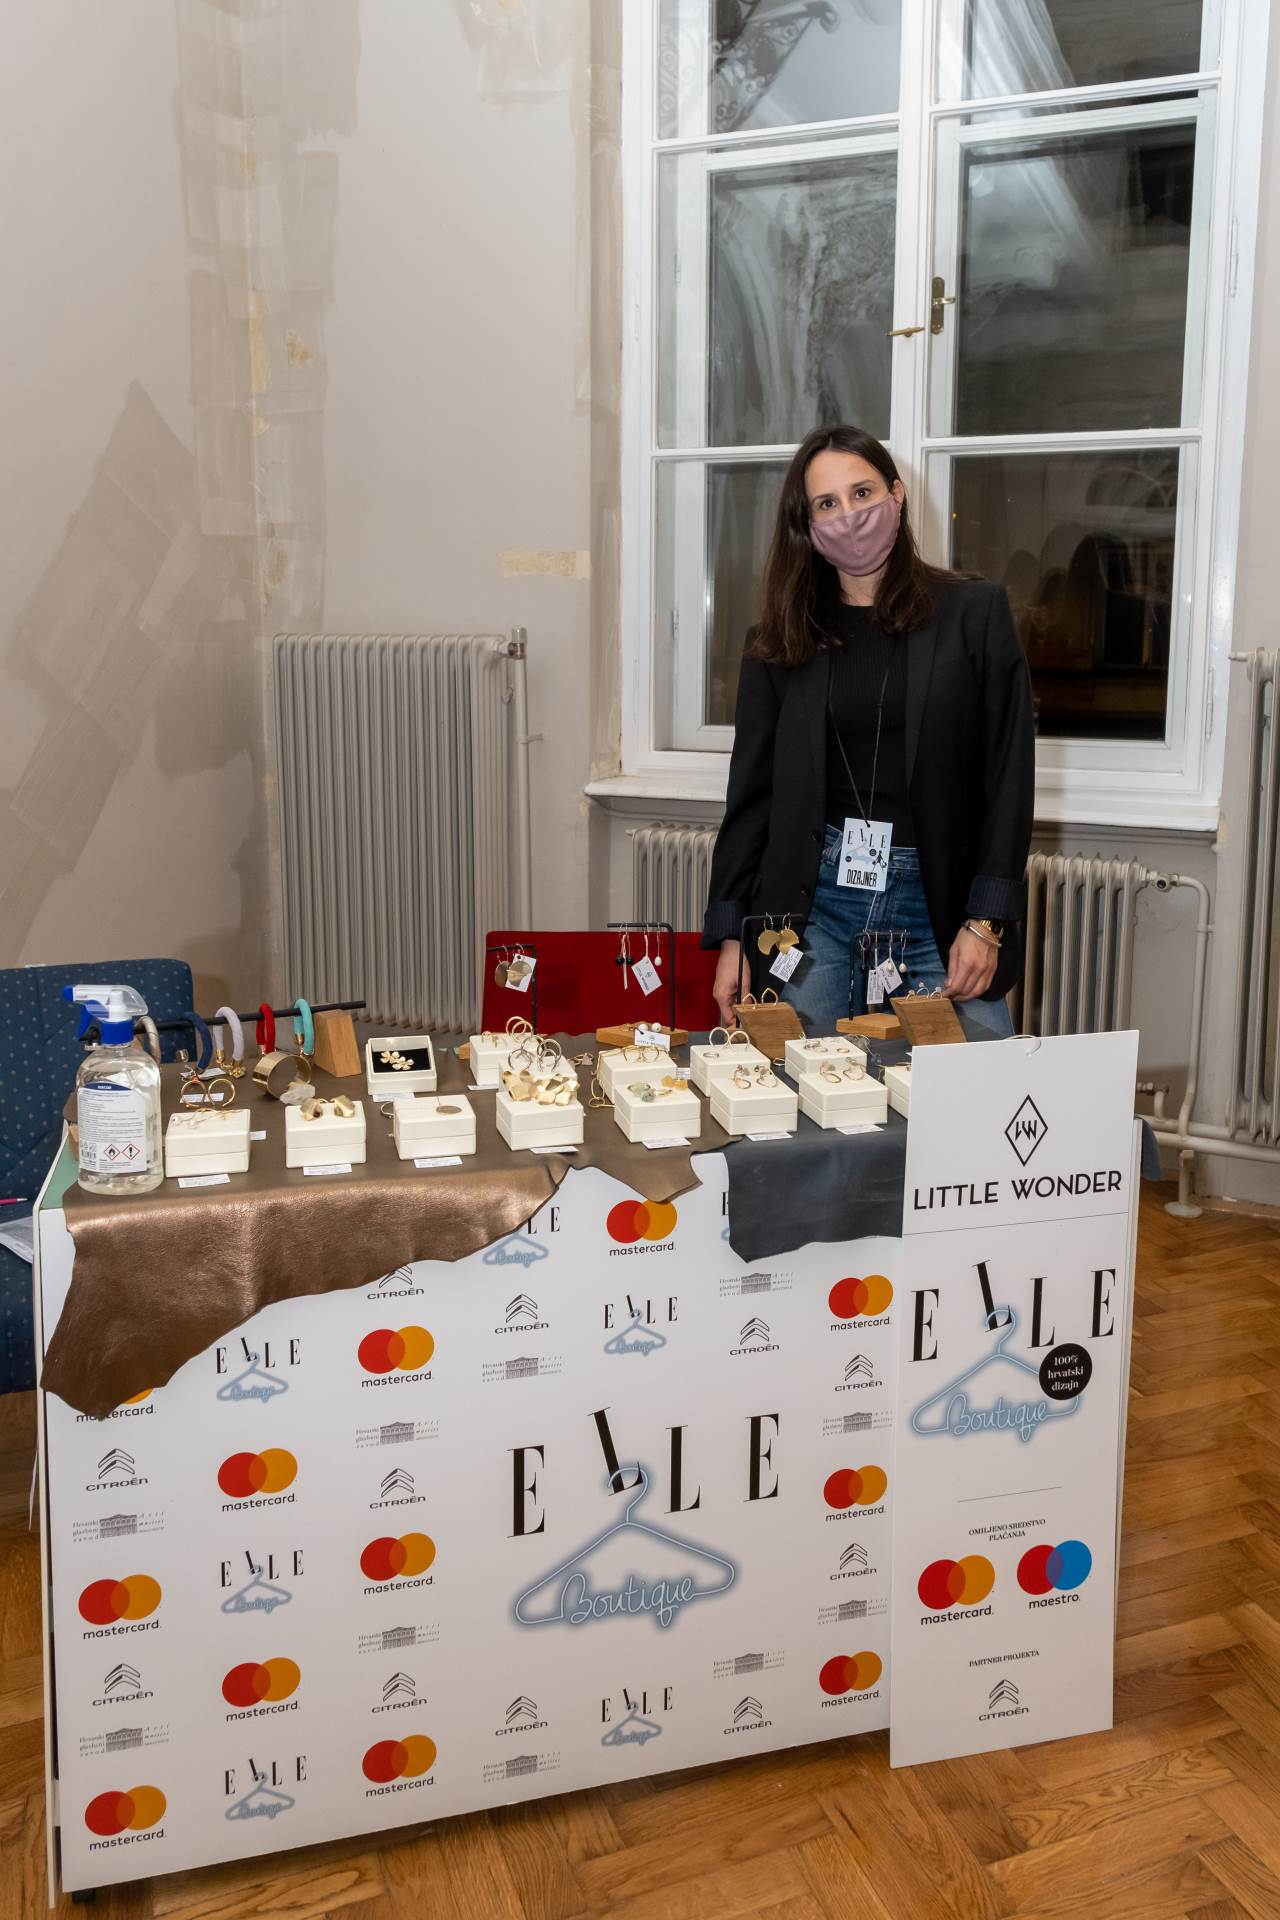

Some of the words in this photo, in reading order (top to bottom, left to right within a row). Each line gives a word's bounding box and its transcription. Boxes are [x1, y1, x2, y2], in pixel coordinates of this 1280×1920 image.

[914, 1181, 999, 1210] LITTLE
[1011, 1170, 1122, 1200] WONDER
[527, 1206, 561, 1234] LE
[604, 1295, 678, 1330] ELLE
[907, 1260, 1116, 1363] ELLE
[215, 1337, 301, 1374] ELLE
[1047, 1367, 1084, 1380] hrvatski
[1053, 1354, 1079, 1366] 100%
[1051, 1380, 1079, 1391] dizajn
[947, 1393, 1049, 1442] Boutique
[506, 1406, 779, 1538] ELLE
[968, 1524, 1008, 1536] OMILJENO
[1008, 1518, 1046, 1530] SREDSTVO
[220, 1549, 304, 1587] ELLE
[561, 1573, 695, 1627] Boutique
[968, 1656, 1002, 1667] PARTNER
[1003, 1650, 1039, 1662] PROJEKTA
[601, 1686, 673, 1722] ELLE
[224, 1755, 306, 1795] ELLE
